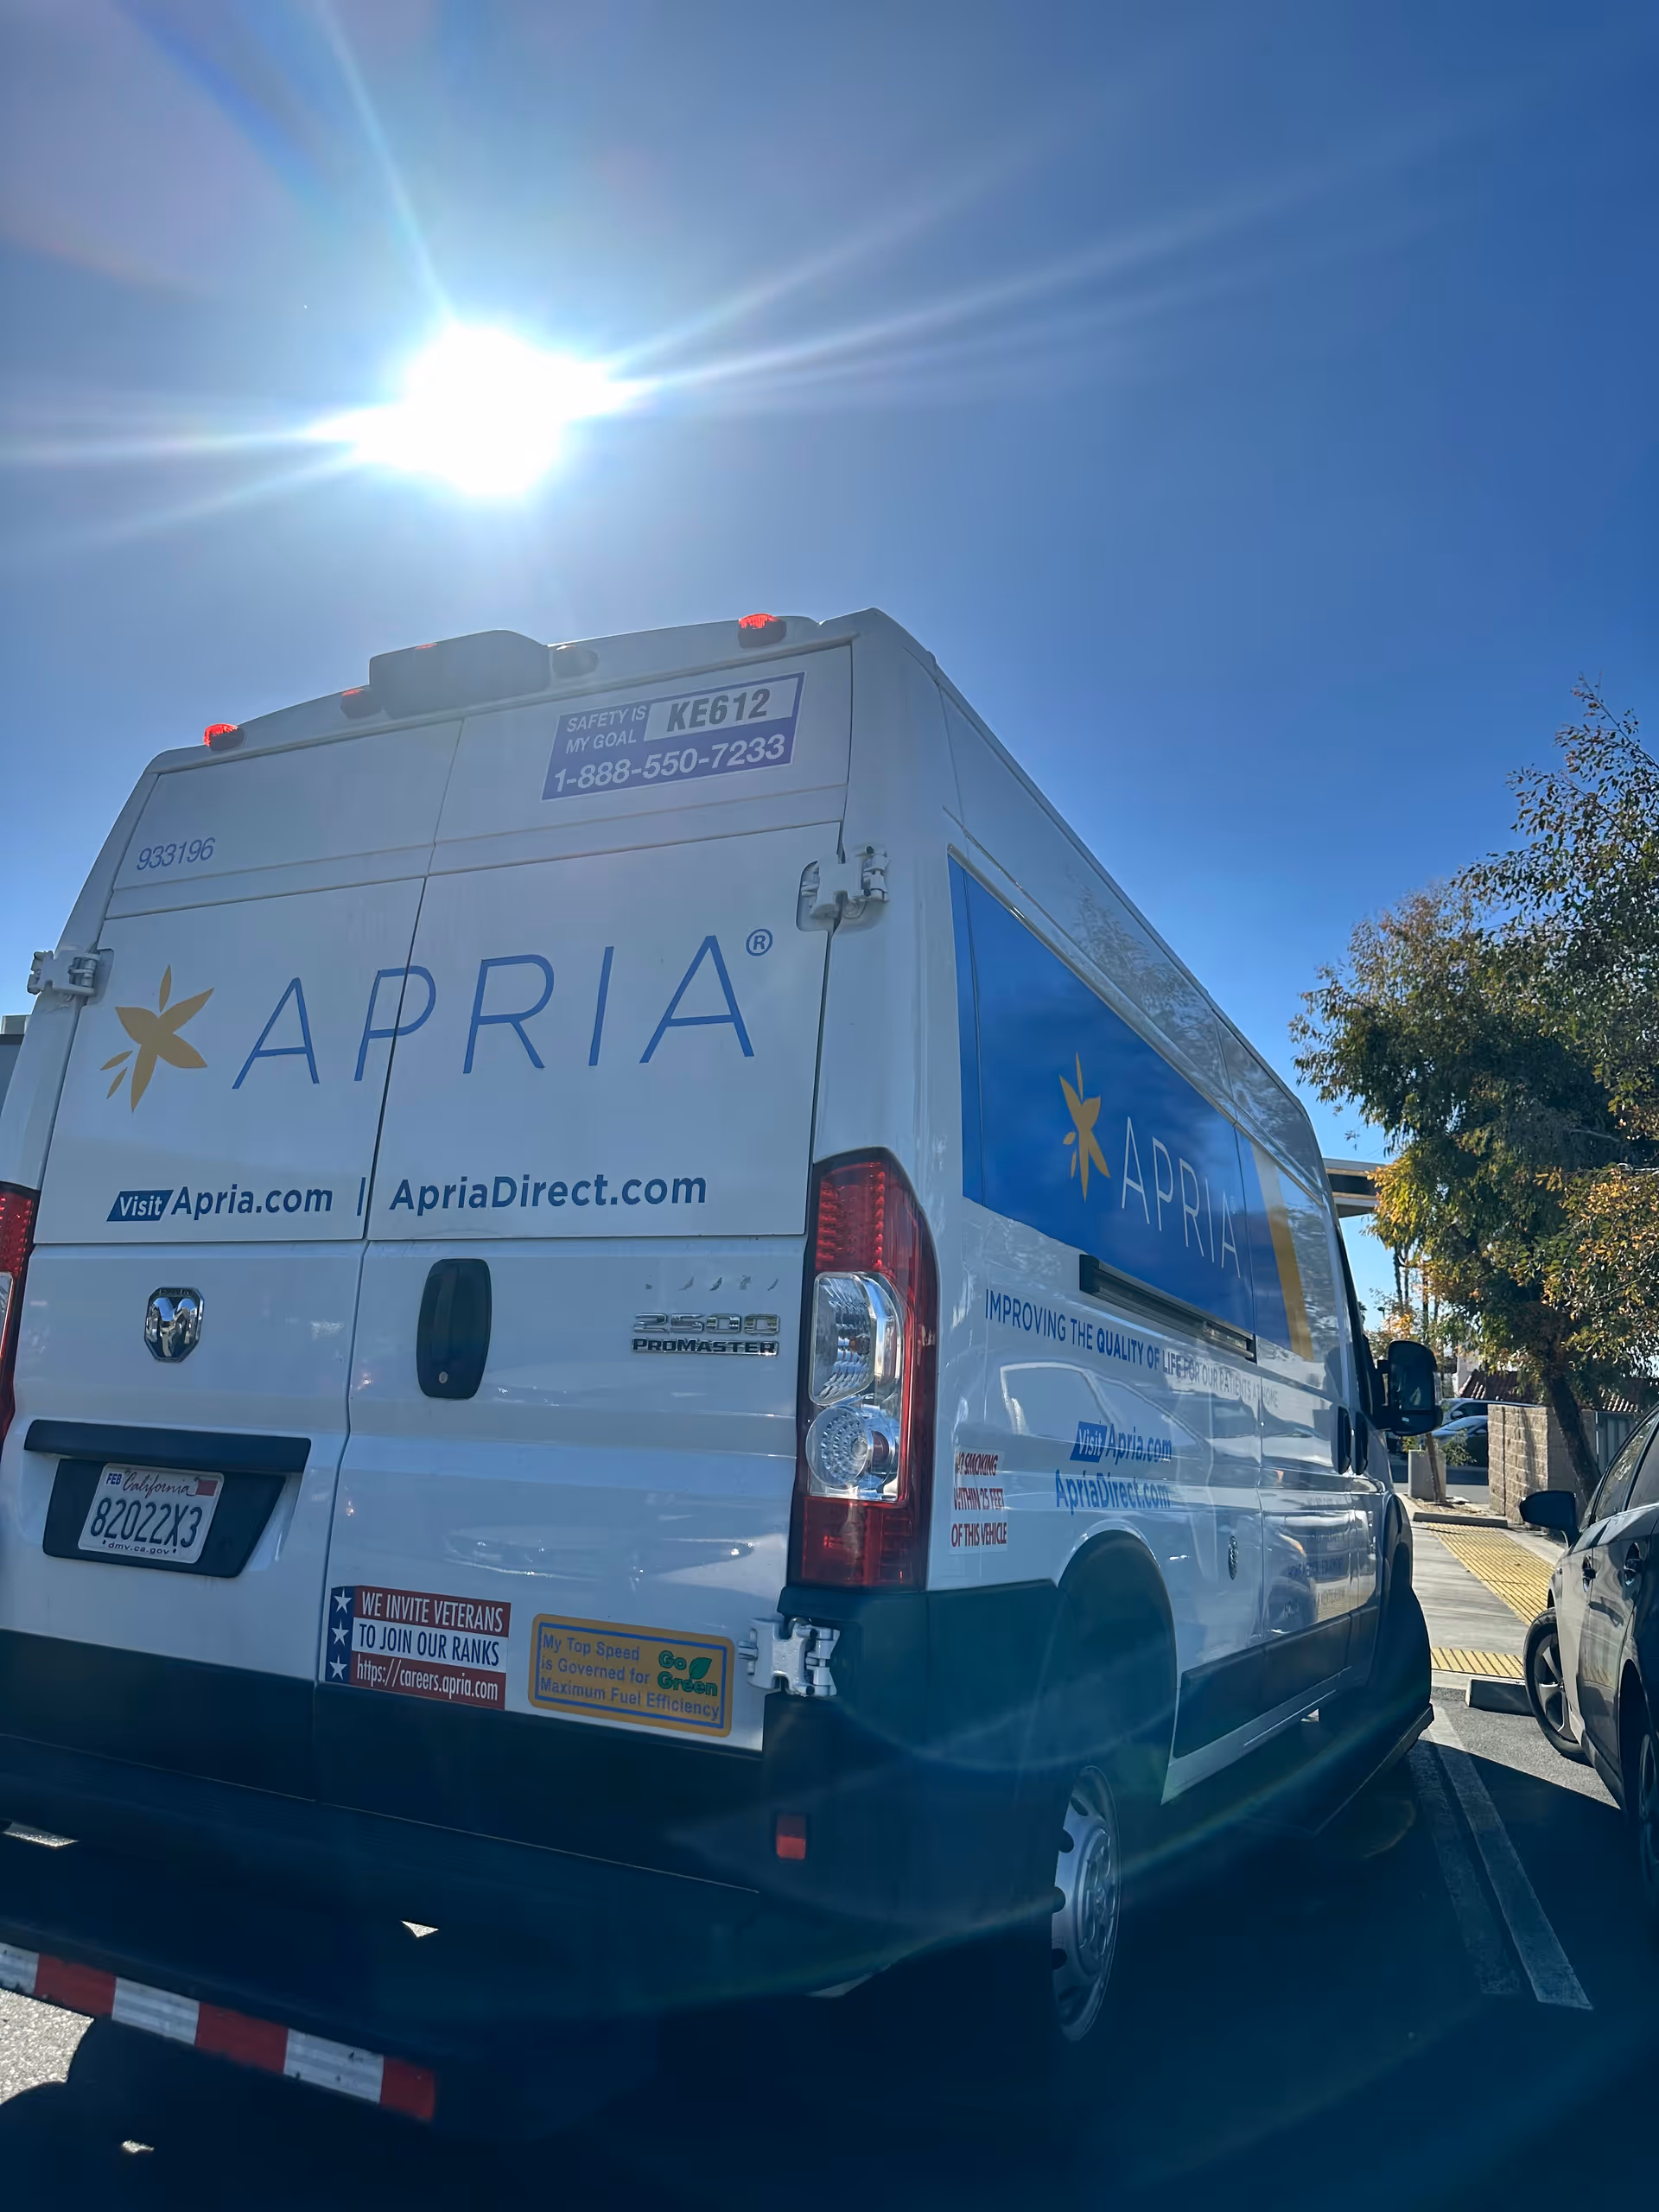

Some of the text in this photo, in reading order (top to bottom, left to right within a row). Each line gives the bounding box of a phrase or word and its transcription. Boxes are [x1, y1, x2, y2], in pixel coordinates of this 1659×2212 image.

[567, 706, 646, 733] SAFETY IS
[666, 689, 771, 733] KE612
[566, 730, 637, 754] MY GOAL
[554, 734, 785, 792] 1-888-550-7233
[137, 837, 216, 870] 933196
[119, 1196, 163, 1217] Visit
[171, 1183, 334, 1220] Apria.com
[389, 1174, 707, 1217] ApriaDirect.com
[1122, 1116, 1241, 1278] APRIA
[633, 1313, 781, 1335] 2500
[985, 1288, 1066, 1342] IMPROVING
[1070, 1318, 1093, 1351] THE
[1096, 1327, 1144, 1365] QUALITY
[1147, 1344, 1160, 1370] OF
[1202, 1363, 1218, 1389] OUR
[1219, 1368, 1252, 1400] PATIENTS
[1079, 1422, 1173, 1465] Visit Apria.com
[963, 1452, 998, 1476] SMOKING
[105, 1471, 197, 1499] FEB California
[953, 1486, 1005, 1510] WITHIN 25 FEET
[1055, 1469, 1172, 1515] ApriaDirect.com
[91, 1497, 203, 1548] 82022X3
[951, 1522, 1007, 1547] OF THIS VEHICLE
[108, 1541, 170, 1555] dmv.ca.gov
[362, 1591, 504, 1633] WE INVITE VETERANS
[359, 1624, 499, 1667] TO JOIN OUR RANKS
[542, 1633, 640, 1661] My Top Speed
[658, 1649, 687, 1670] Go
[357, 1653, 499, 1700] https://careers.apria.com
[541, 1655, 651, 1685] is Governed for
[657, 1671, 718, 1696] Green
[540, 1676, 720, 1721] Maximum Fuel Efficiency
